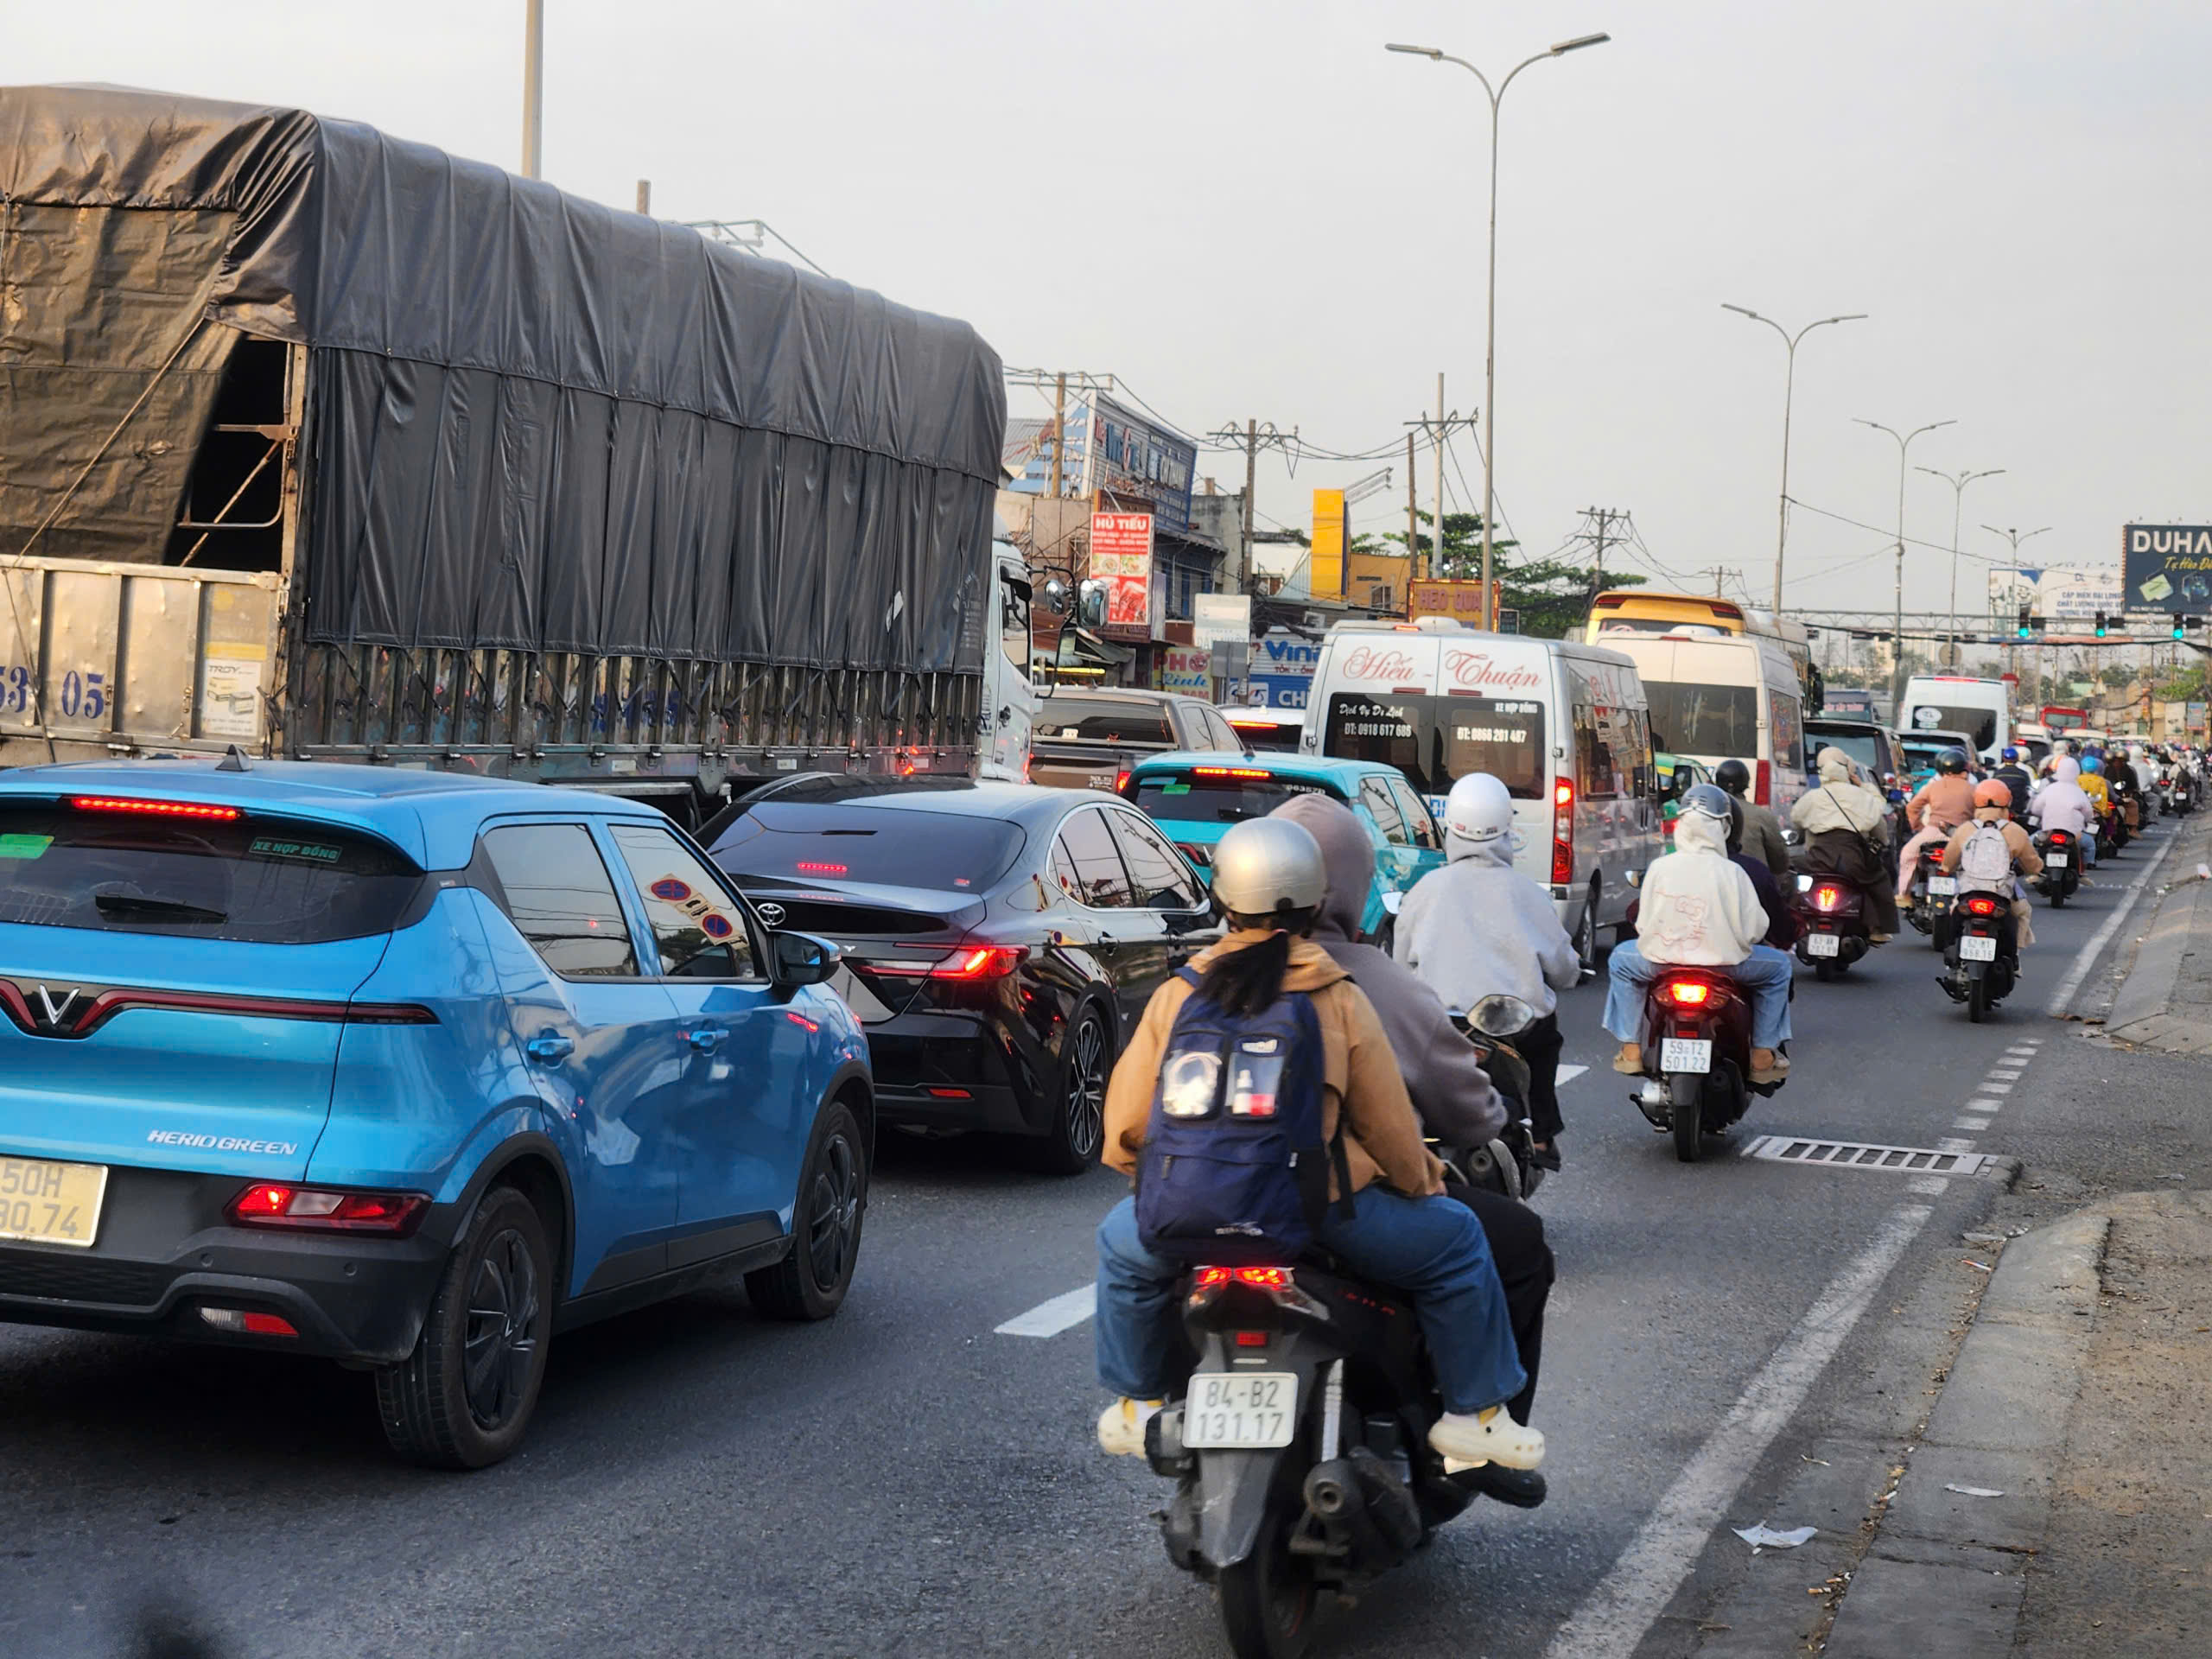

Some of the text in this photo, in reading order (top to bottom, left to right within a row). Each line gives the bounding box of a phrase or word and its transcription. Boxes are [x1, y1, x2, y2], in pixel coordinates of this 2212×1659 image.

[62, 671, 105, 719] 05
[1279, 690, 1311, 707] CH
[253, 842, 271, 851] XE
[147, 1129, 297, 1155] HERIO GREEN
[1, 1161, 64, 1198] 50H
[1204, 1380, 1280, 1408] 84-B2
[1198, 1412, 1284, 1441] 131.17
